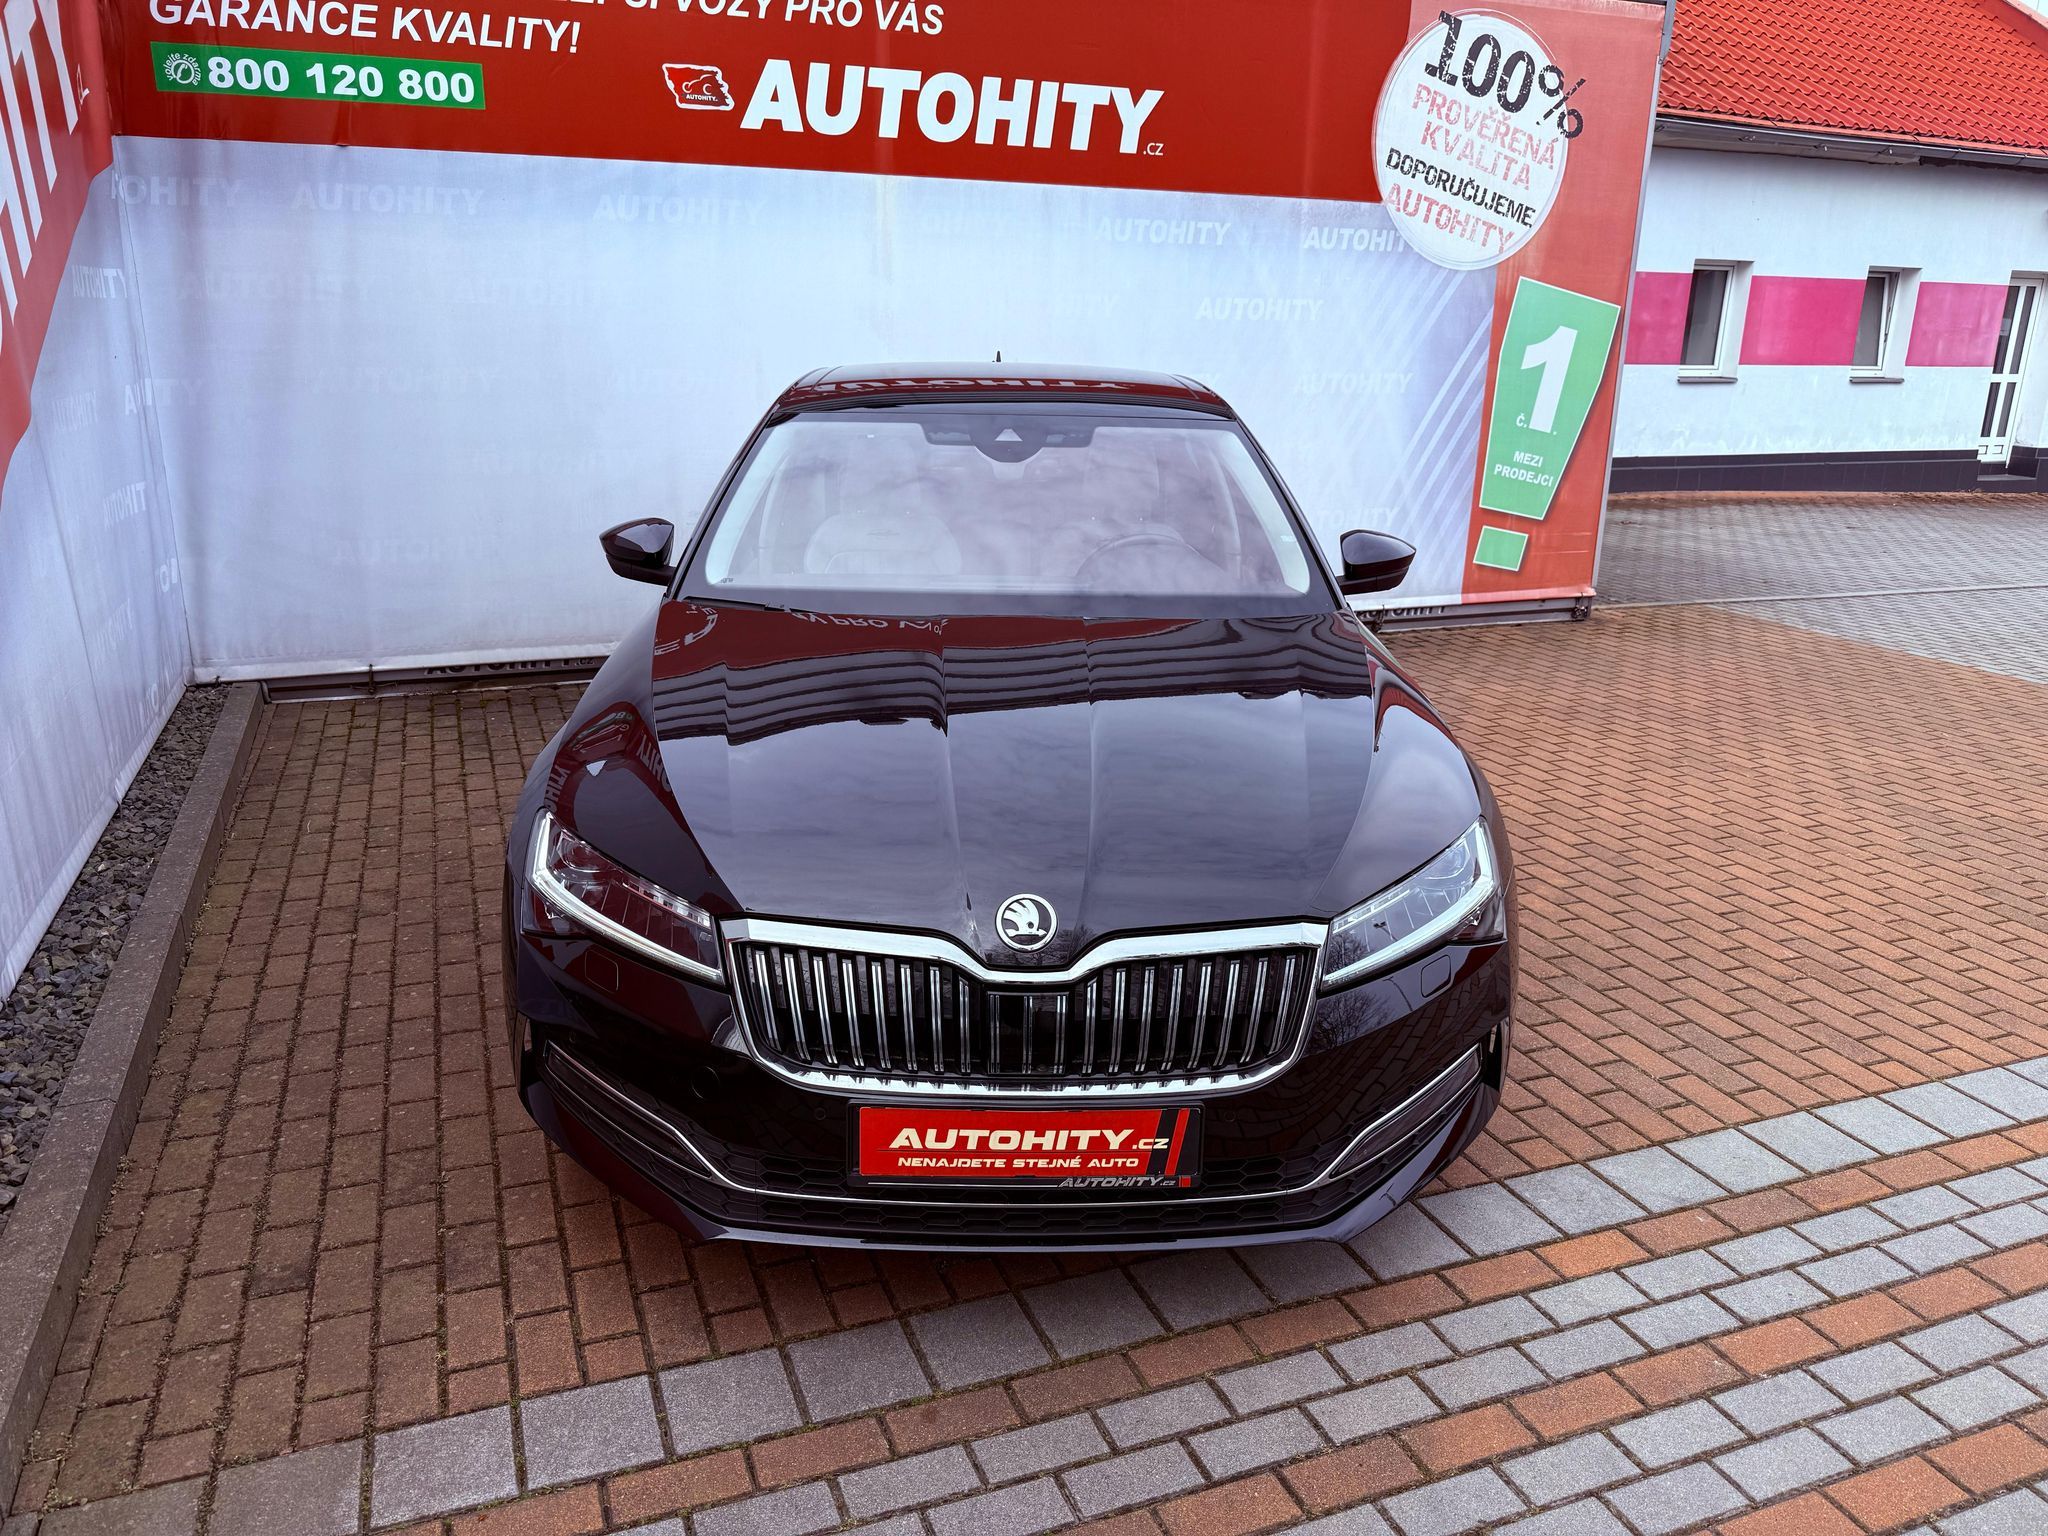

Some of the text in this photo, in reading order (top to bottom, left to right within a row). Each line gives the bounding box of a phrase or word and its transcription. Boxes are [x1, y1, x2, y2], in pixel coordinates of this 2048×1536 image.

[149, 0, 582, 55] GARANCE KVALITY!
[784, 0, 863, 28] PRO
[874, 0, 945, 36] VÁS
[207, 56, 290, 93] 800
[306, 62, 384, 98] 120
[398, 68, 475, 104] 800
[1424, 10, 1587, 139] 100%
[1411, 82, 1558, 171] PROVĚŘENÁ
[1419, 119, 1531, 191] KVALITA
[290, 181, 486, 216] AUTOHITY
[1385, 147, 1537, 229] DOPORUČUJEME
[591, 193, 769, 226] AUTOHITY
[1387, 182, 1516, 254] AUTOHITY
[1094, 216, 1233, 247] AUTOHITY
[1303, 225, 1408, 253] AUTOHIT
[1194, 297, 1324, 321] AUTOHITY
[1494, 464, 1555, 489] PRODEJCI
[1513, 451, 1543, 469] MEZI
[888, 1127, 1170, 1151] AUTOHITY.cz
[897, 1155, 1140, 1168] NENAJDETE STEJNÉ AUTO
